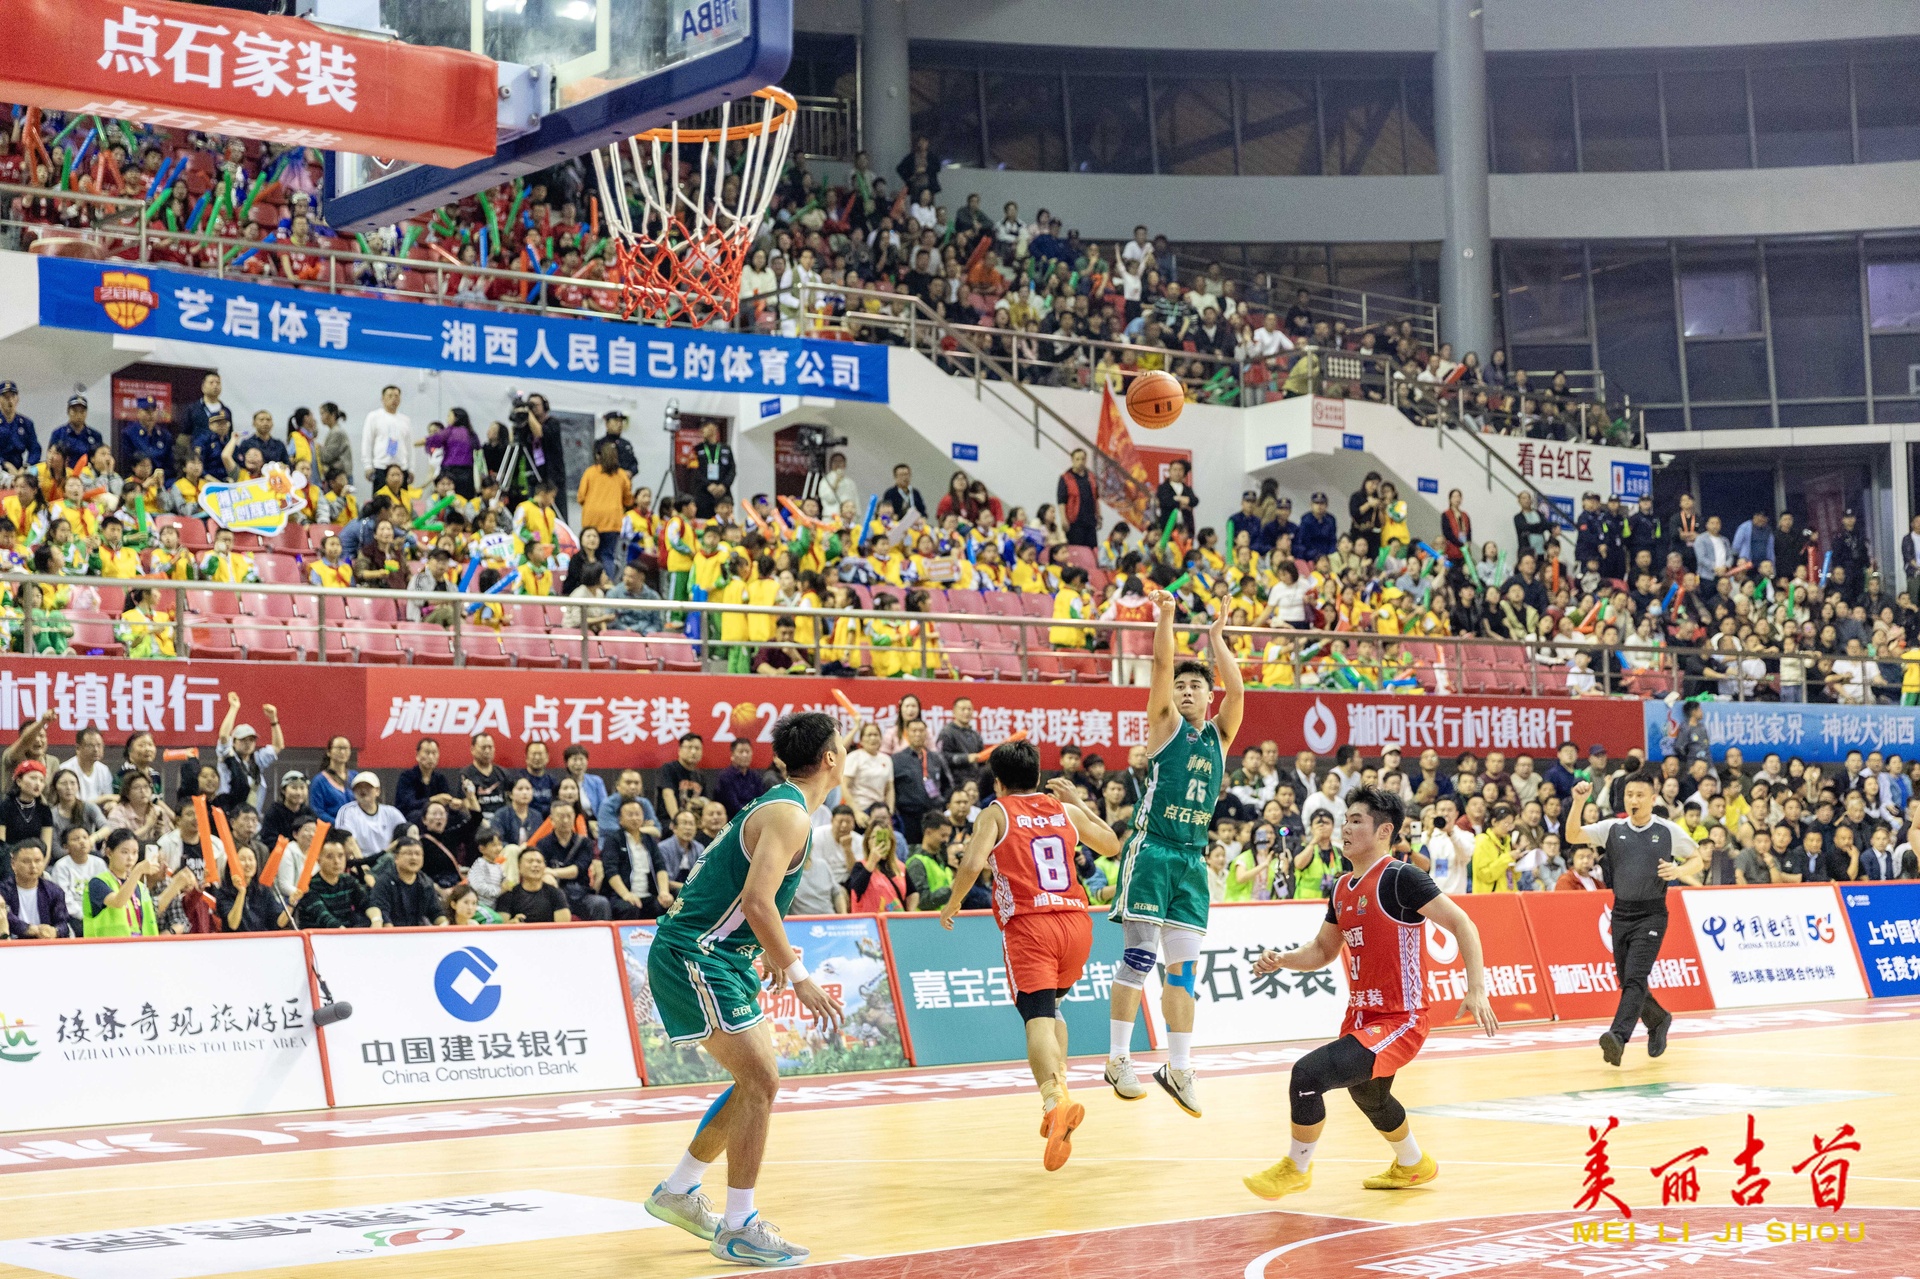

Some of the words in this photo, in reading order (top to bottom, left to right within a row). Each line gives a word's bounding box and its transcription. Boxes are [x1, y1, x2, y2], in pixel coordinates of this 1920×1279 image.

[97, 6, 358, 113] 点石家装
[73, 100, 343, 147] 点石家装
[1517, 442, 1594, 482] 看台红区
[0, 670, 221, 732] 村镇银行
[380, 694, 511, 740] 湘BA
[520, 694, 691, 745] 点石家装
[1347, 703, 1573, 749] 湘西长行村镇银行
[1821, 712, 1915, 755] 神秘大湘西
[1030, 834, 1072, 893] 8
[1733, 915, 1796, 941] 中国电信
[1805, 913, 1836, 944] 5G
[61, 1047, 115, 1062] AIZHAI
[118, 1043, 197, 1058] WONDERS
[200, 1039, 266, 1054] TOURIST
[272, 1036, 308, 1050] AREA
[361, 1029, 588, 1066] 中国建设银行
[381, 1069, 430, 1085] China
[436, 1062, 533, 1081] Construction
[538, 1060, 578, 1076] Bank
